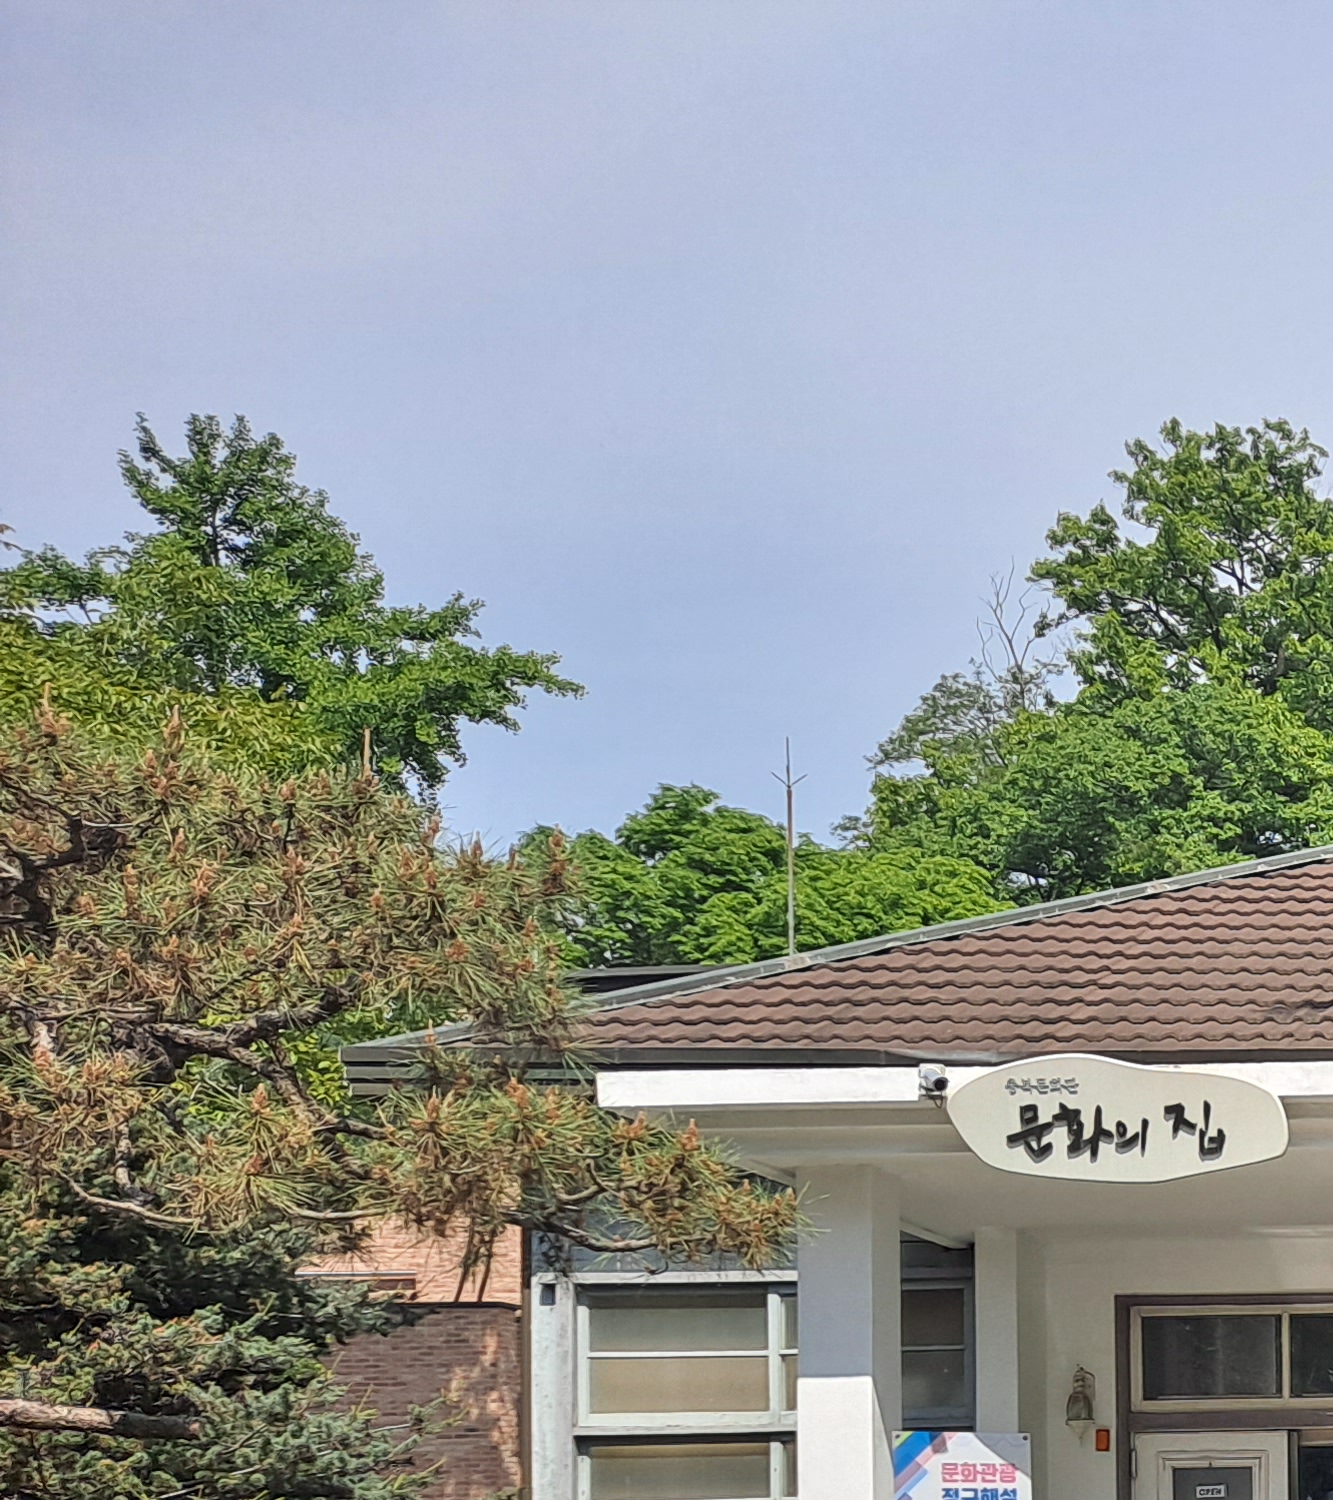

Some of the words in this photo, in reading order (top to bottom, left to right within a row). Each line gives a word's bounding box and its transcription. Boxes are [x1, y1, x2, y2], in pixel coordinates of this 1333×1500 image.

[1006, 1101, 1150, 1164] 문화의
[1163, 1099, 1227, 1162] 집
[941, 1462, 1019, 1484] 문화관광
